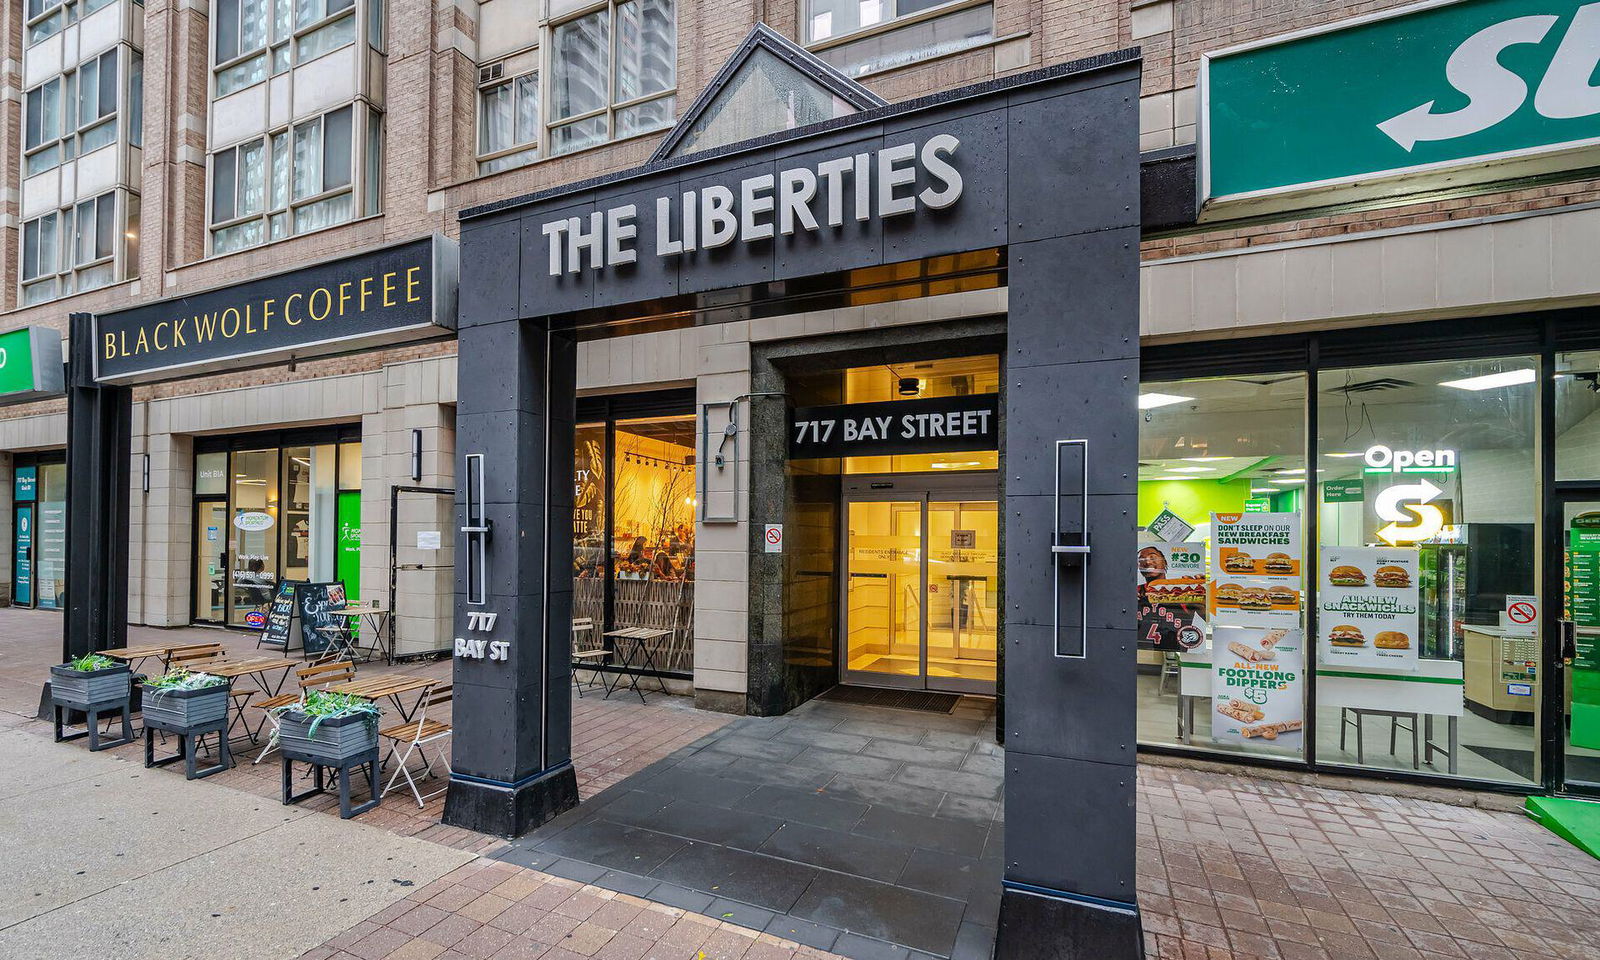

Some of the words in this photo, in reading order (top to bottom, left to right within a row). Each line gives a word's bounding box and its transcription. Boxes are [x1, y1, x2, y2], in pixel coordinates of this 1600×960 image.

[542, 203, 637, 276] THE
[656, 133, 964, 257] LIBERTIES
[105, 318, 187, 360] BLACK
[194, 298, 275, 344] WOLF
[284, 266, 421, 326] COFFEE
[795, 419, 836, 444] 717
[843, 415, 893, 442] BAY
[901, 409, 992, 439] STREET
[1364, 445, 1455, 473] Open
[574, 470, 590, 481] TY
[581, 509, 593, 520] YOU
[1153, 514, 1171, 532] PASS
[1171, 553, 1201, 563] #30
[1323, 602, 1417, 614] SNACKWICHES
[1341, 595, 1398, 605] ALL-NEW
[467, 611, 498, 632] 717
[1137, 603, 1182, 628] APTORS
[1146, 623, 1162, 645] 4
[454, 637, 488, 659] BAY
[489, 640, 511, 661] ST
[1218, 668, 1296, 681] FOOTLONG
[1234, 661, 1280, 671] ALL-NEW
[1226, 678, 1288, 690] DIPPERS
[1244, 687, 1268, 705] $5
